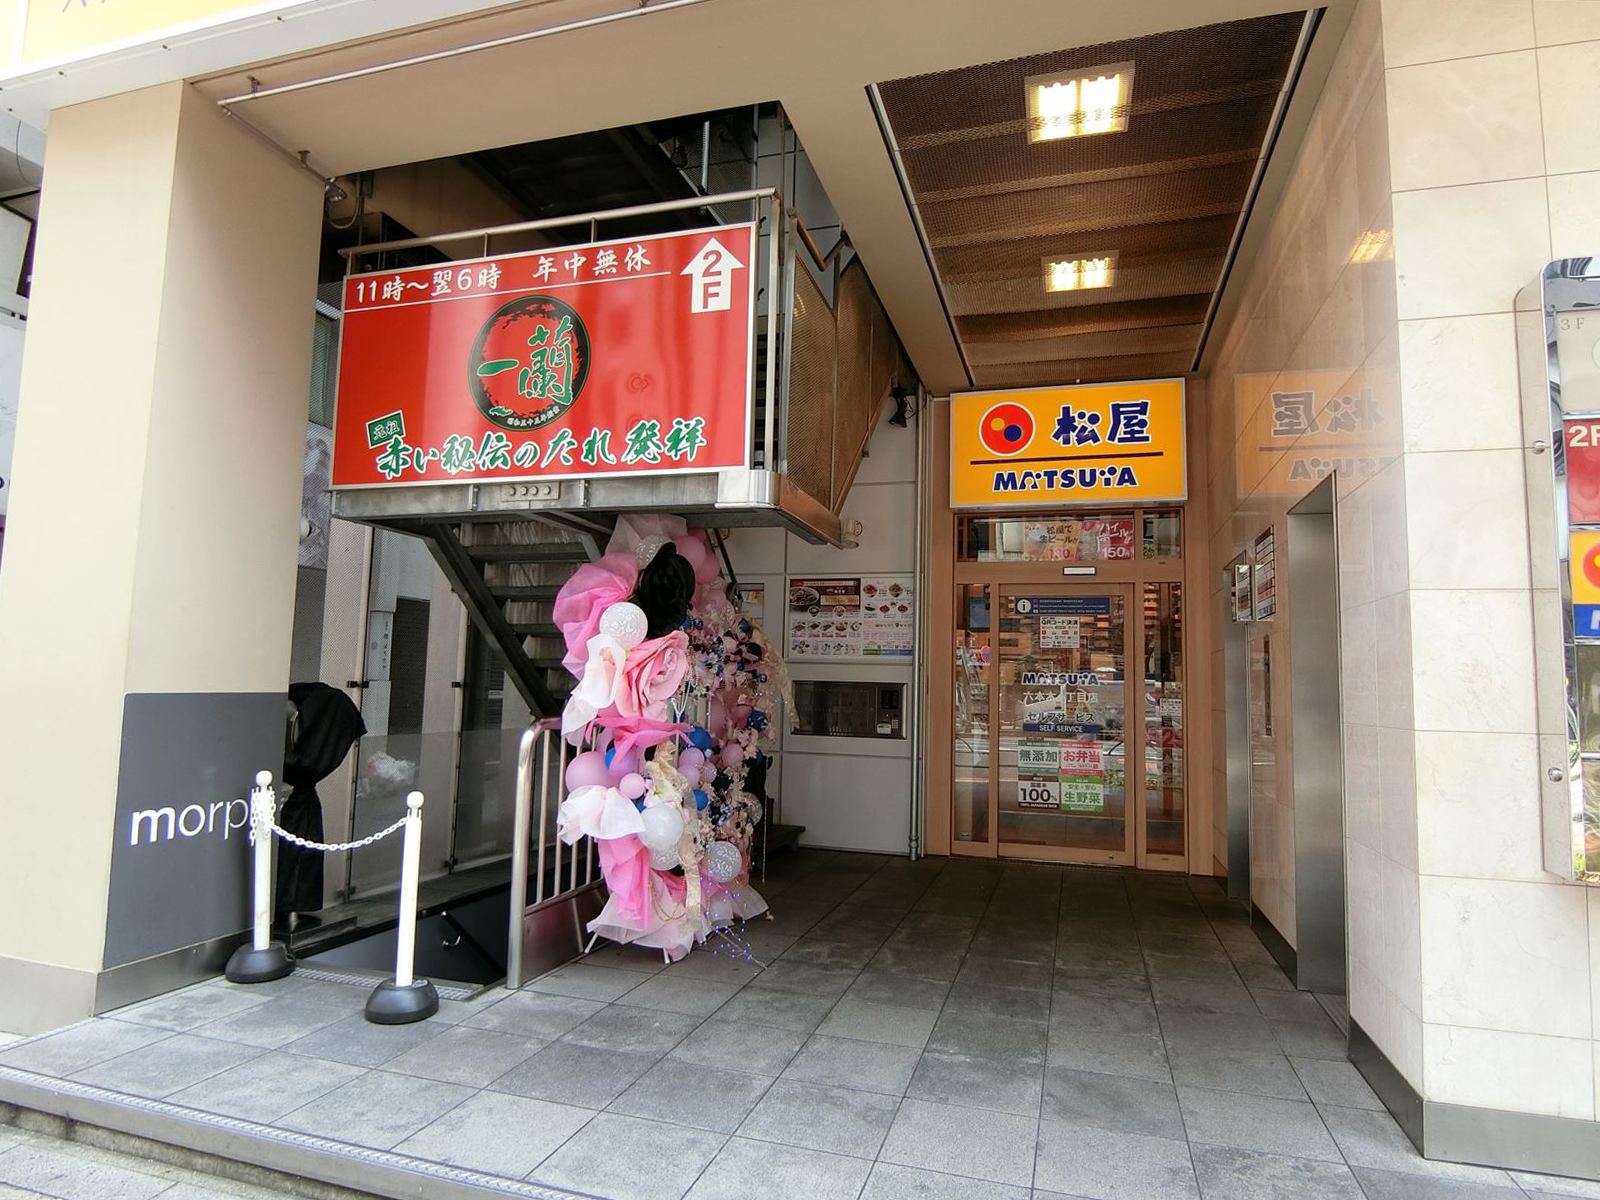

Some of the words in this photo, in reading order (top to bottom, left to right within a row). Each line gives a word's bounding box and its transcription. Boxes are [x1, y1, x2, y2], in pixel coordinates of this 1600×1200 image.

[532, 243, 652, 283] 年中無休
[477, 315, 574, 405] 一蘭
[1051, 400, 1151, 447] 松屋
[373, 422, 398, 440] 元祖
[377, 417, 707, 479] 赤い秘伝のたれ発祥
[992, 466, 1138, 491] MATSUYA
[1021, 672, 1099, 686] MATSUYA
[1023, 691, 1098, 703] 六本木丁目店
[1028, 711, 1095, 723] セルフサービス
[1039, 724, 1055, 732] SELF
[1056, 725, 1084, 733] SERVICE
[1019, 749, 1058, 763] 無添加
[1063, 749, 1100, 763] お弁当
[1064, 791, 1100, 804] 生野菜
